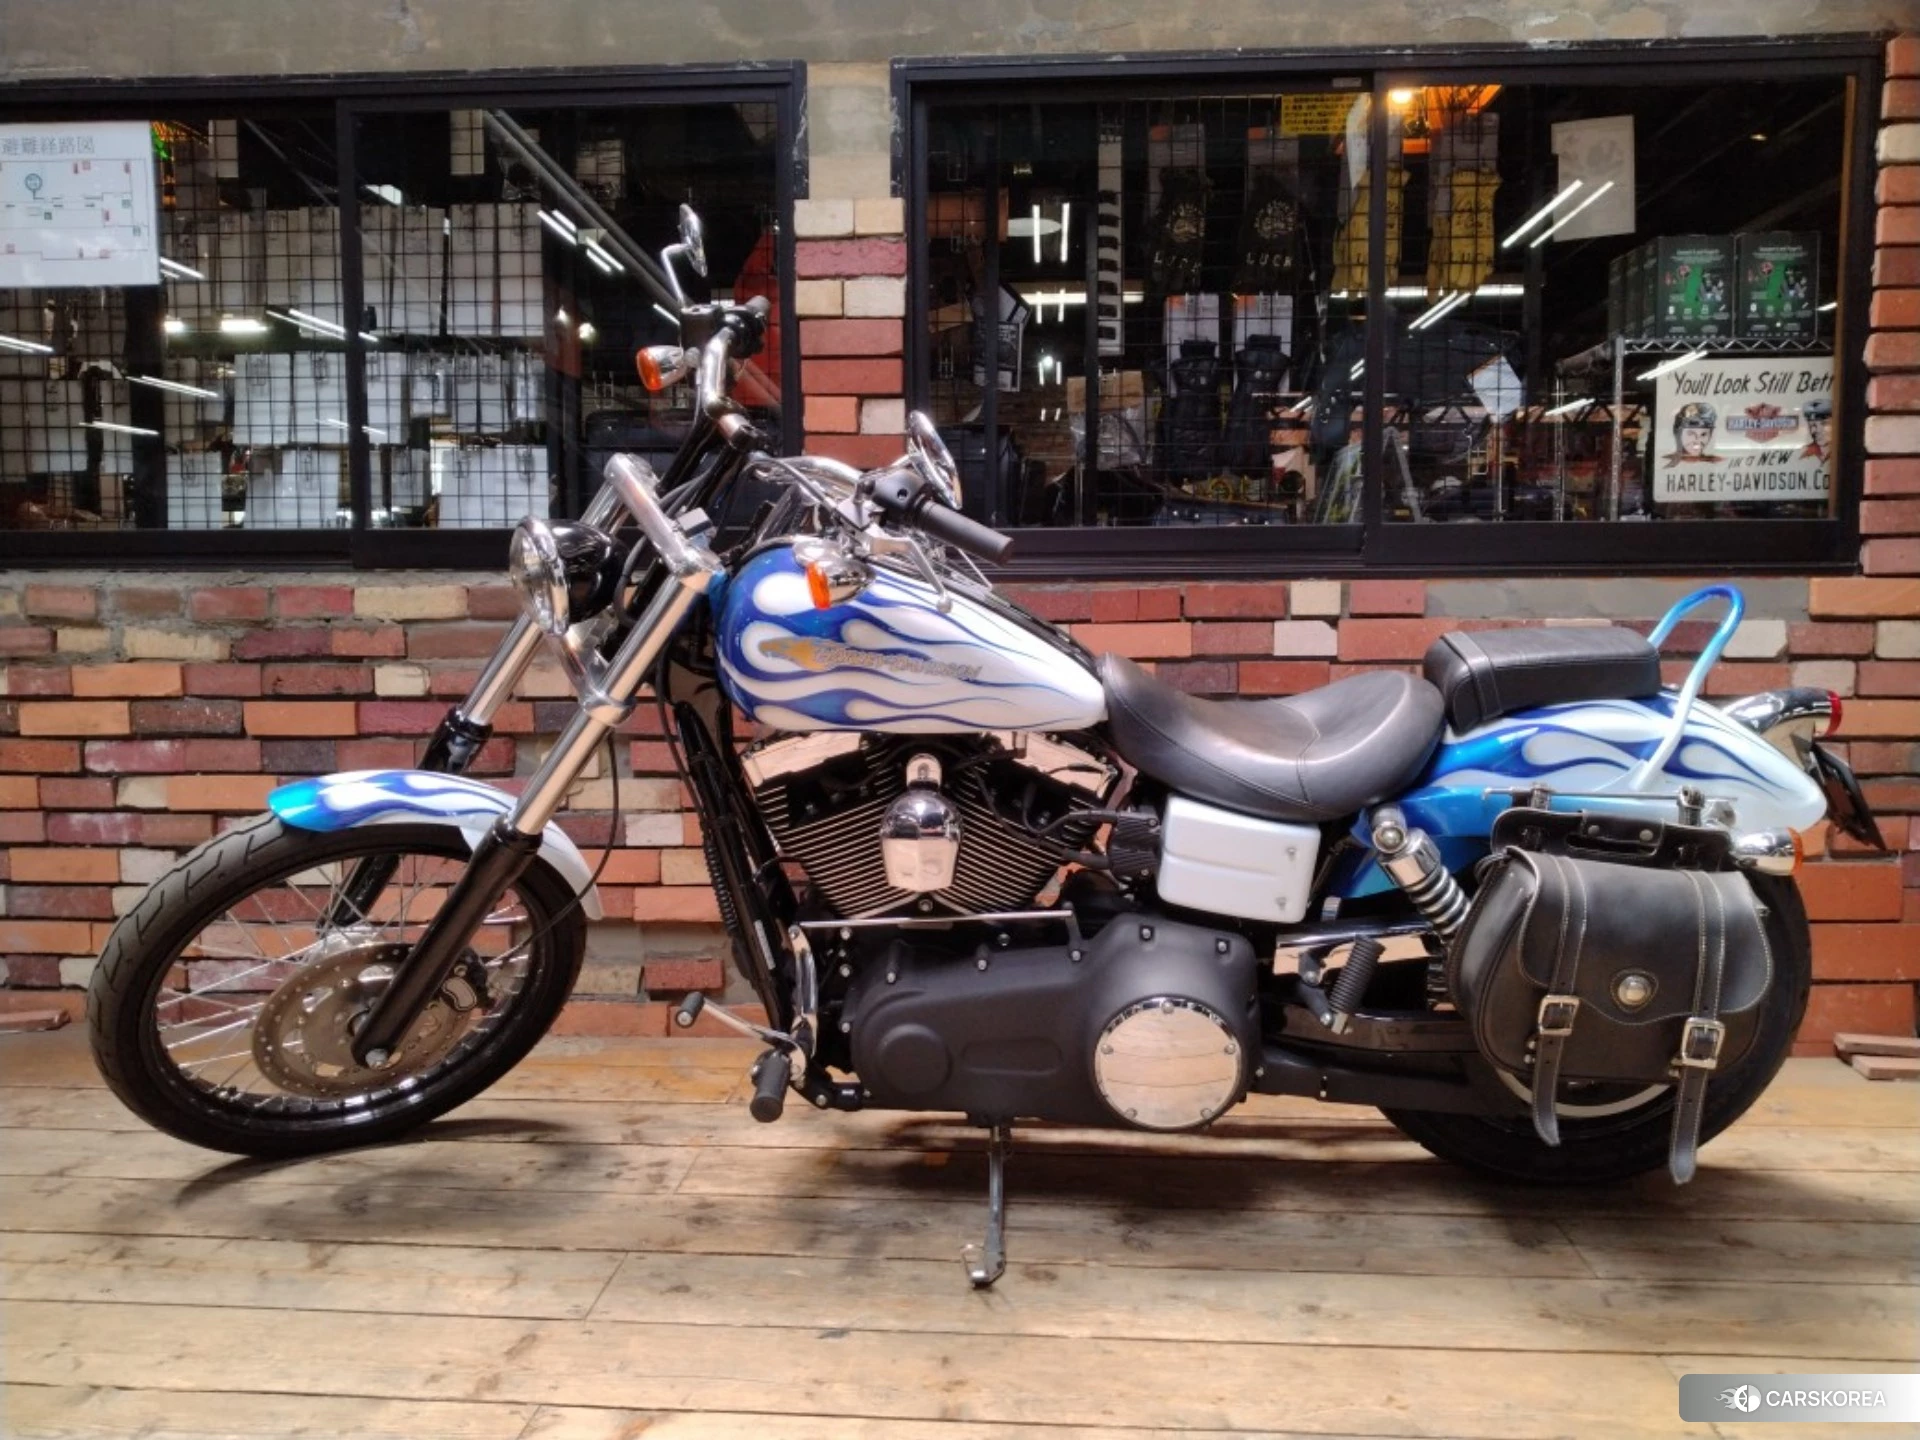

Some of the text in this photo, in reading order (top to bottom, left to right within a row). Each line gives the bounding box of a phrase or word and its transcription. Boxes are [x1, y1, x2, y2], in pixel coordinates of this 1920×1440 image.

[1713, 371, 1751, 395] Look
[1754, 370, 1793, 394] Still
[1757, 451, 1794, 466] NEW
